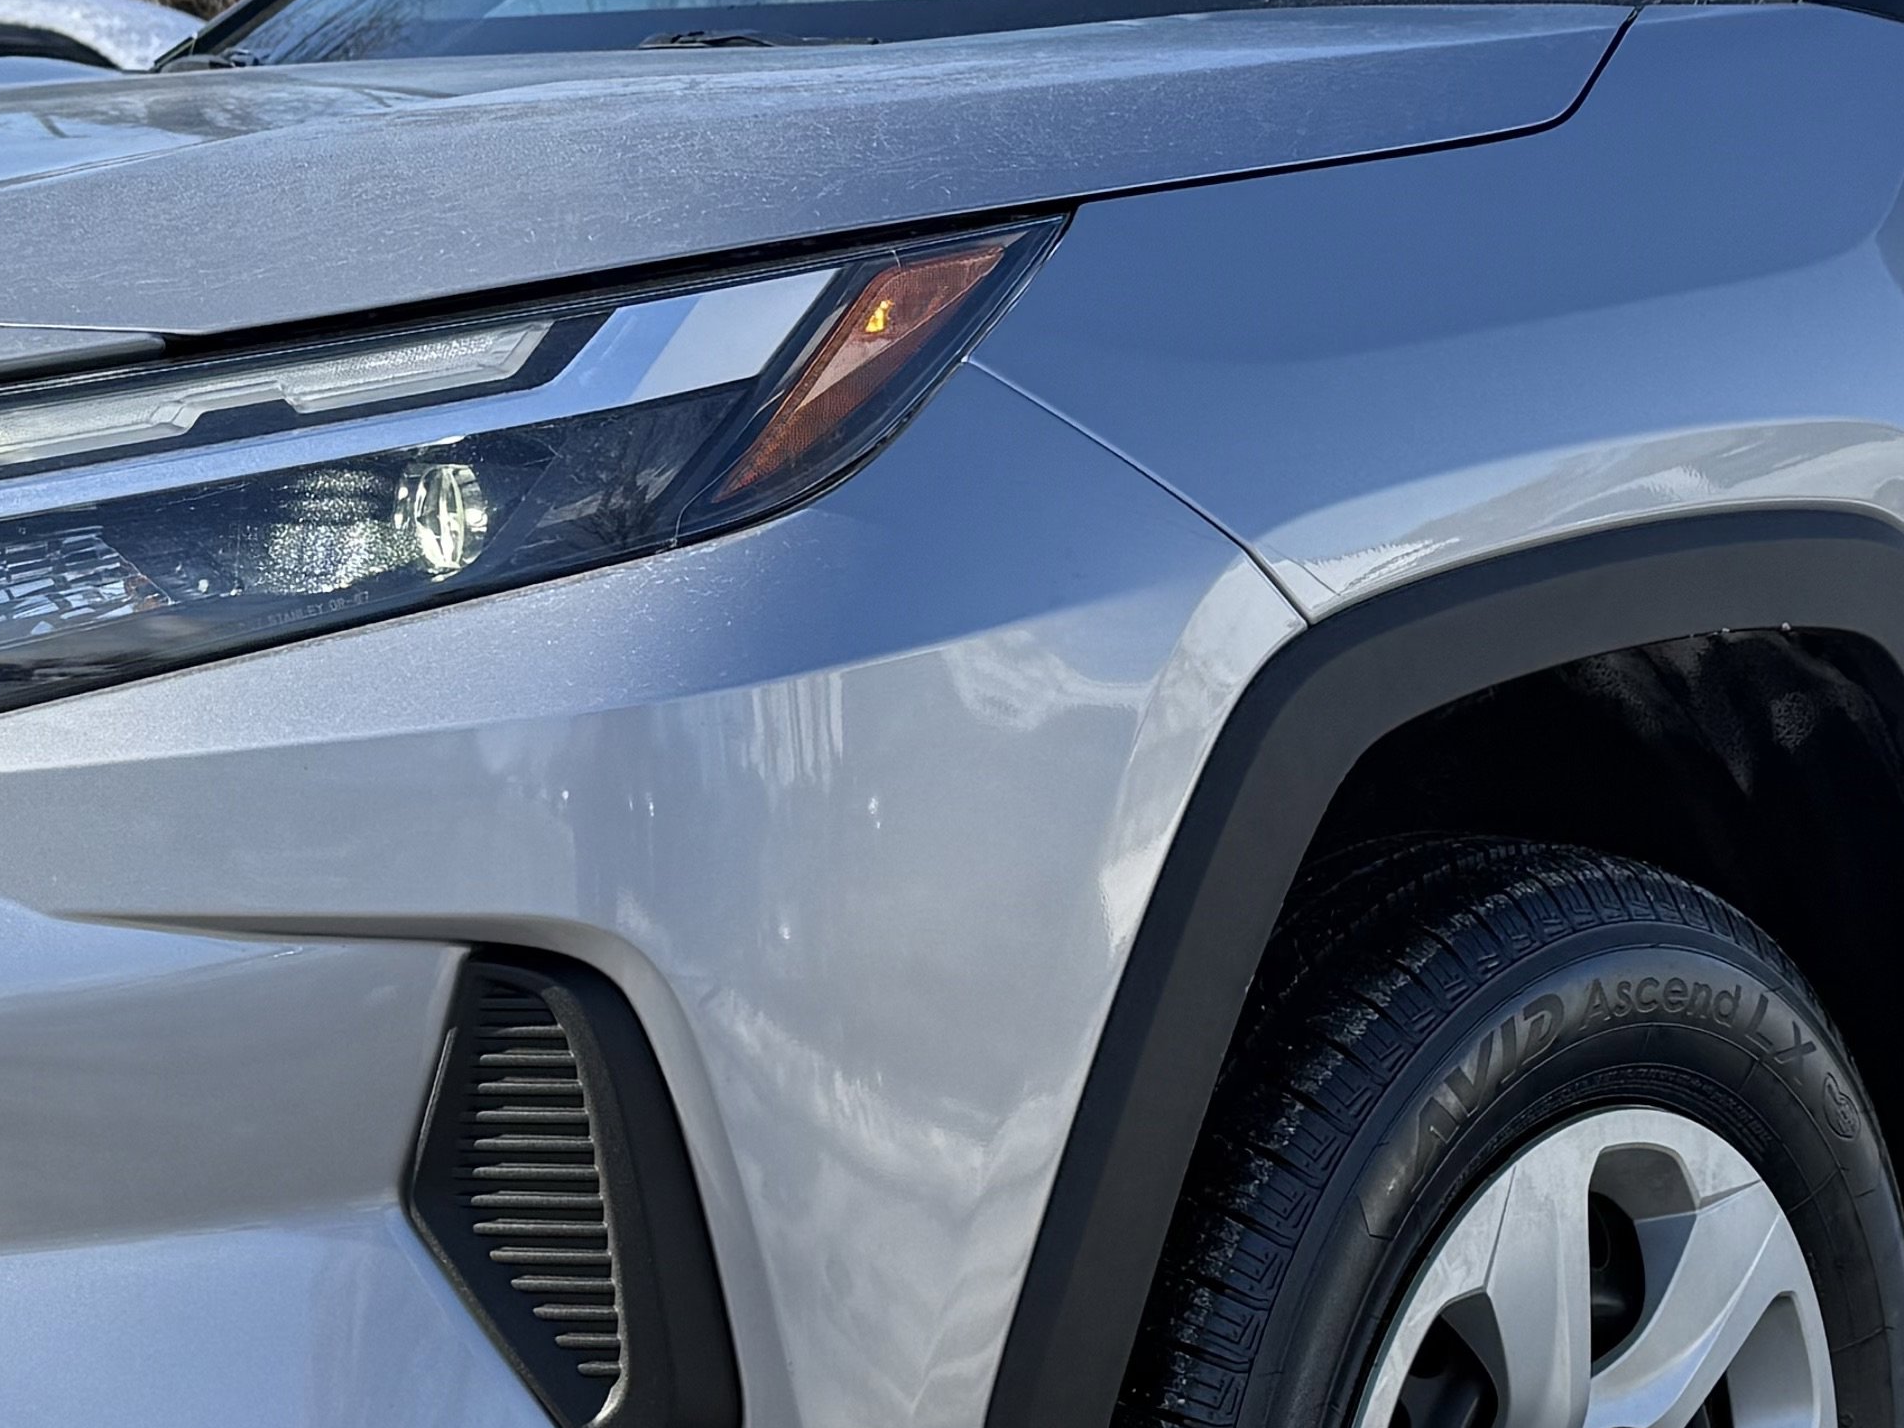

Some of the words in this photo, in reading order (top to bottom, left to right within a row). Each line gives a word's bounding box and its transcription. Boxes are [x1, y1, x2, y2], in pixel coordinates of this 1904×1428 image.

[1411, 993, 1565, 1192] AVID
[1579, 977, 1742, 1031] Ascend
[1744, 983, 1817, 1086] LX
